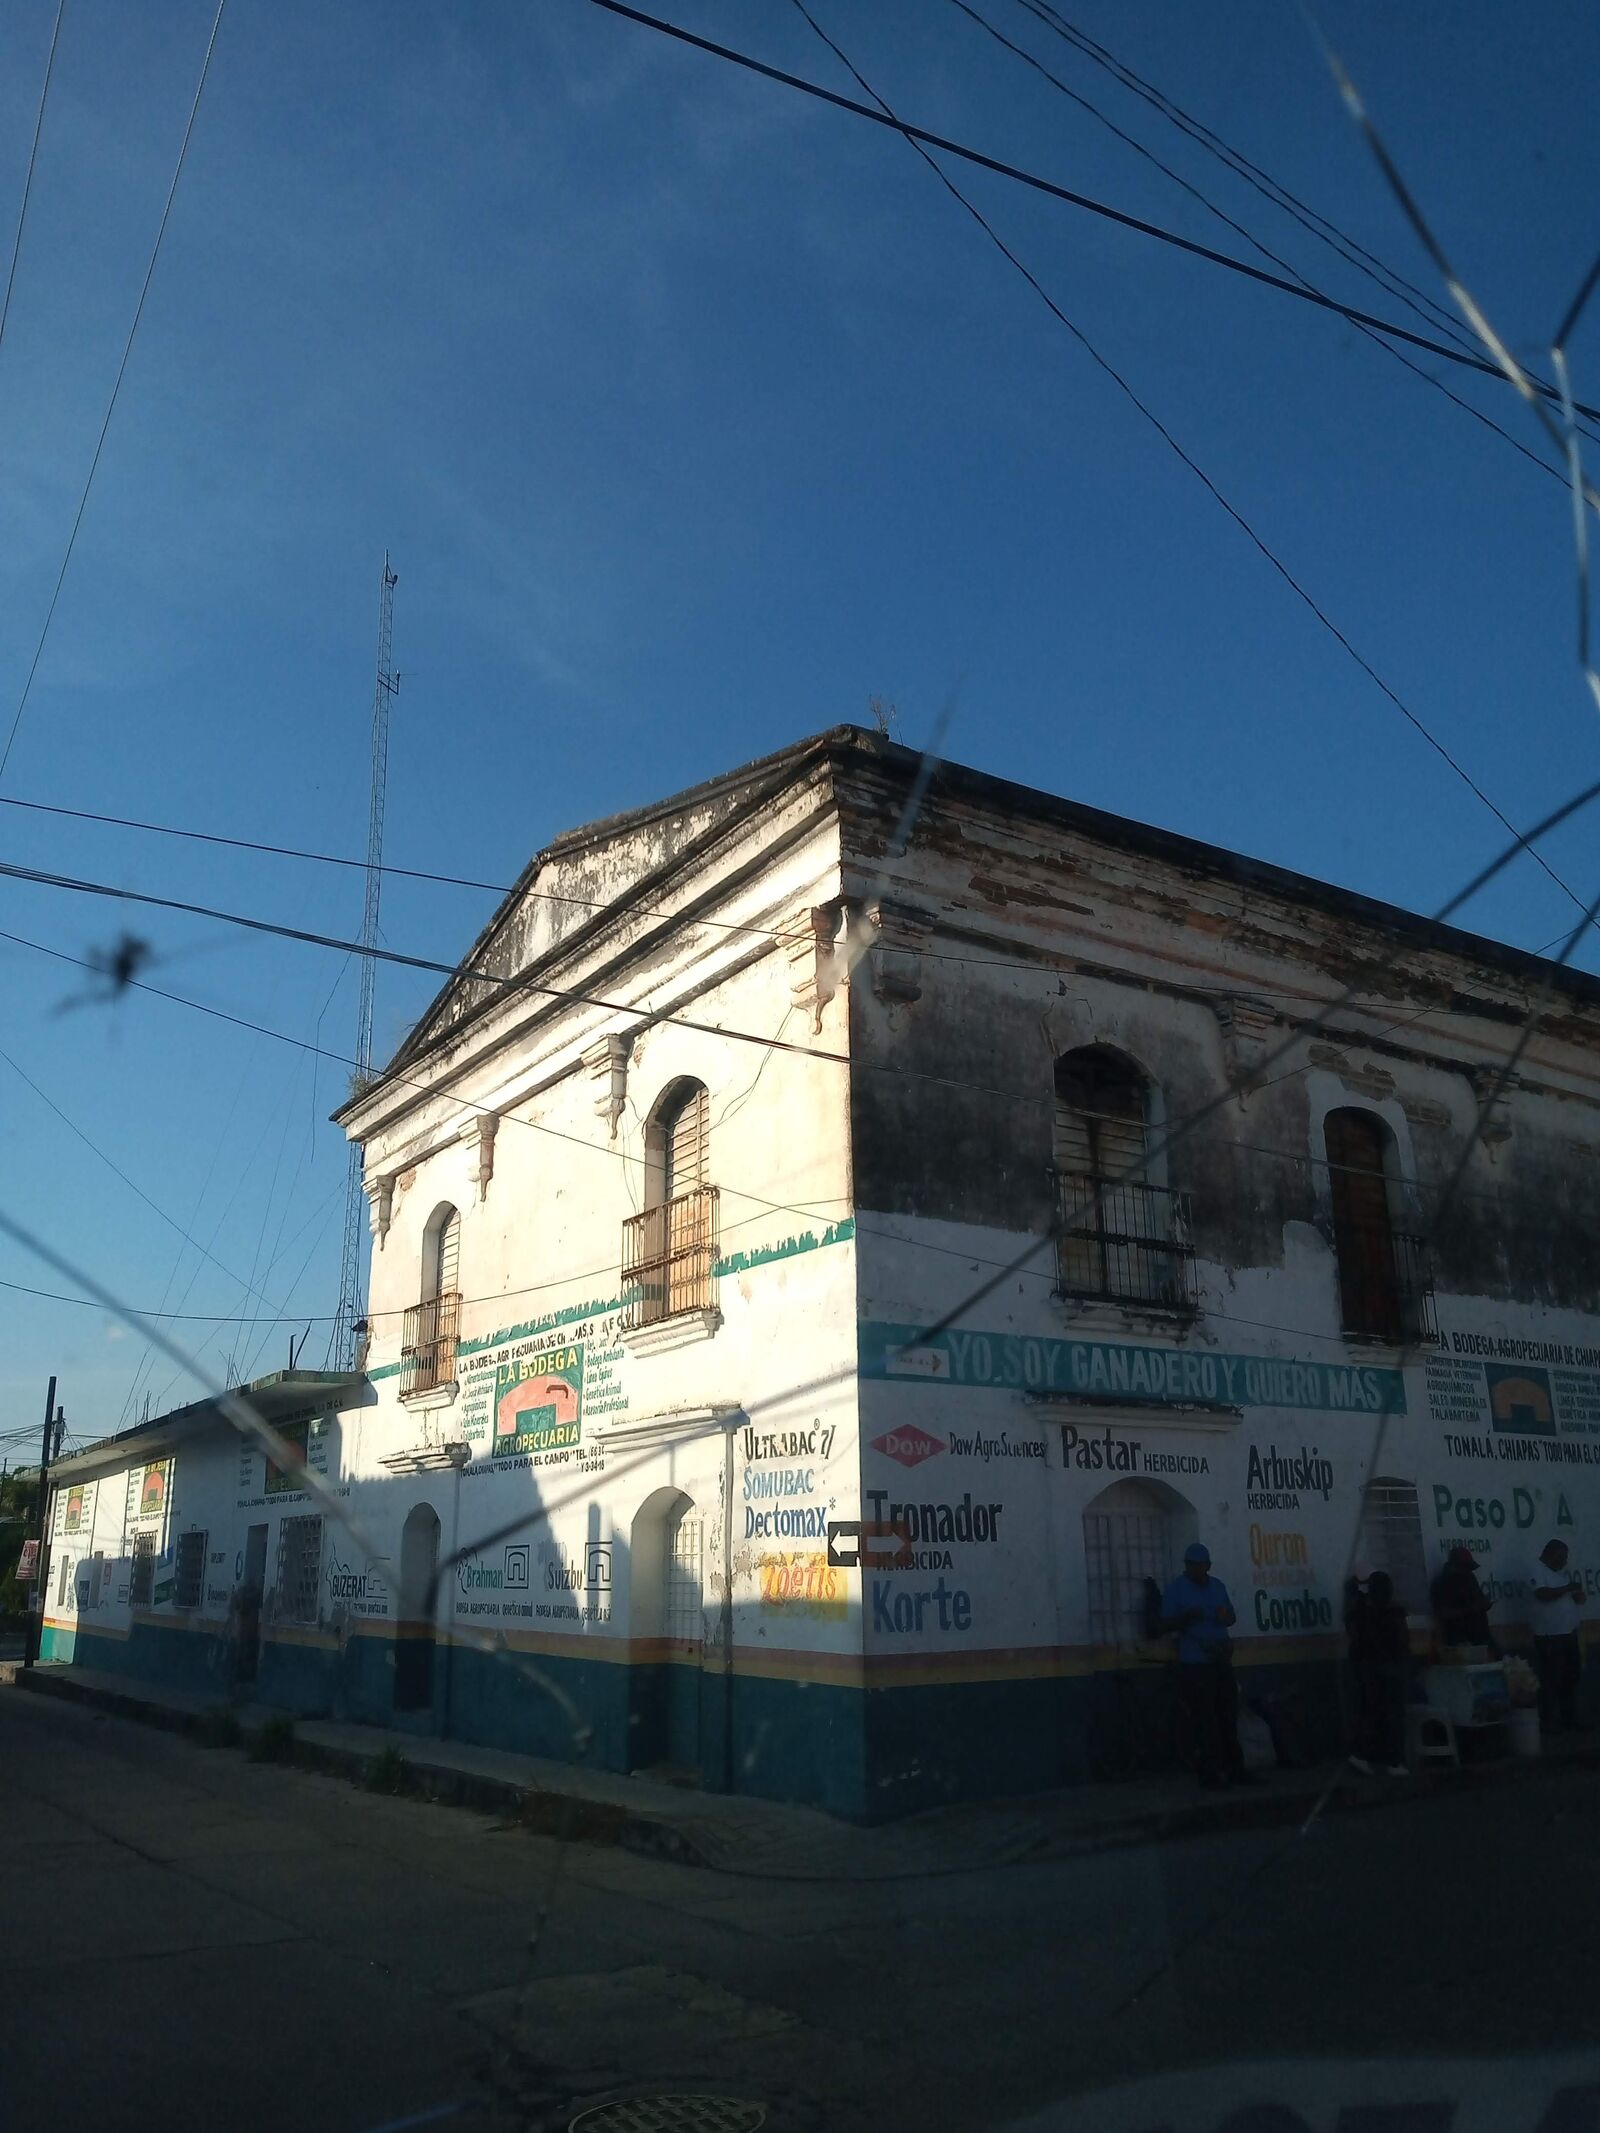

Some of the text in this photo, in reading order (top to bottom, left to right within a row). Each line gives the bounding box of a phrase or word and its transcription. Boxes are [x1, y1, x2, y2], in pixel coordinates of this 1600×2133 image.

[499, 1363, 516, 1385] LA
[519, 1348, 579, 1381] BODEGA
[1497, 1338, 1563, 1363] AGROPECUARIA
[1564, 1345, 1574, 1366] DE
[1071, 1345, 1217, 1400] GANADERO
[1218, 1356, 1241, 1404] Y
[1244, 1360, 1319, 1408] QUIERO
[494, 1424, 579, 1457] AGROPECUARIA
[1061, 1424, 1210, 1474] Pastar HERBICIDA
[513, 1456, 534, 1470] PARA
[534, 1455, 542, 1466] EL
[1246, 1444, 1334, 1502] Arbuskip
[744, 1501, 829, 1539] Dectomax
[866, 1489, 1003, 1543] Tronador
[1247, 1492, 1301, 1511] HERBICIDA
[1432, 1483, 1506, 1529] Paso
[333, 1574, 367, 1599] GUZERAT
[466, 1559, 503, 1590] Brahman
[547, 1559, 583, 1591] Suizbu
[872, 1576, 973, 1633] Korte
[1254, 1588, 1332, 1633] Combo
